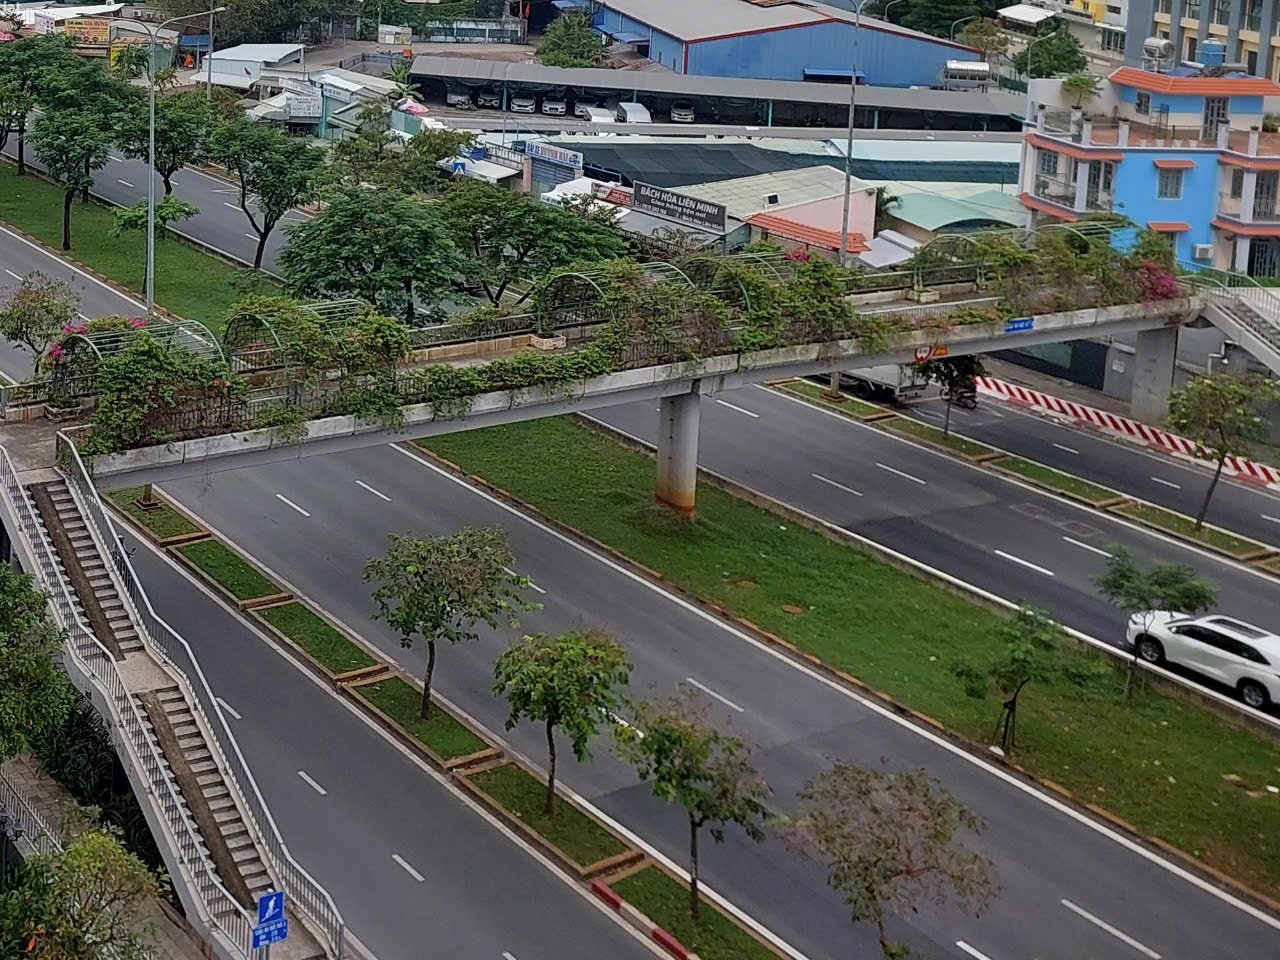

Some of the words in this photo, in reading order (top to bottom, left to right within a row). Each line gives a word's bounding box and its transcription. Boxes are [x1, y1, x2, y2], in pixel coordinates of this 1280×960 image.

[640, 186, 661, 200] BÁCH
[661, 191, 677, 204] HÓA
[678, 196, 696, 210] LIÊN
[696, 203, 719, 216] MINH
[650, 198, 665, 208] Giao
